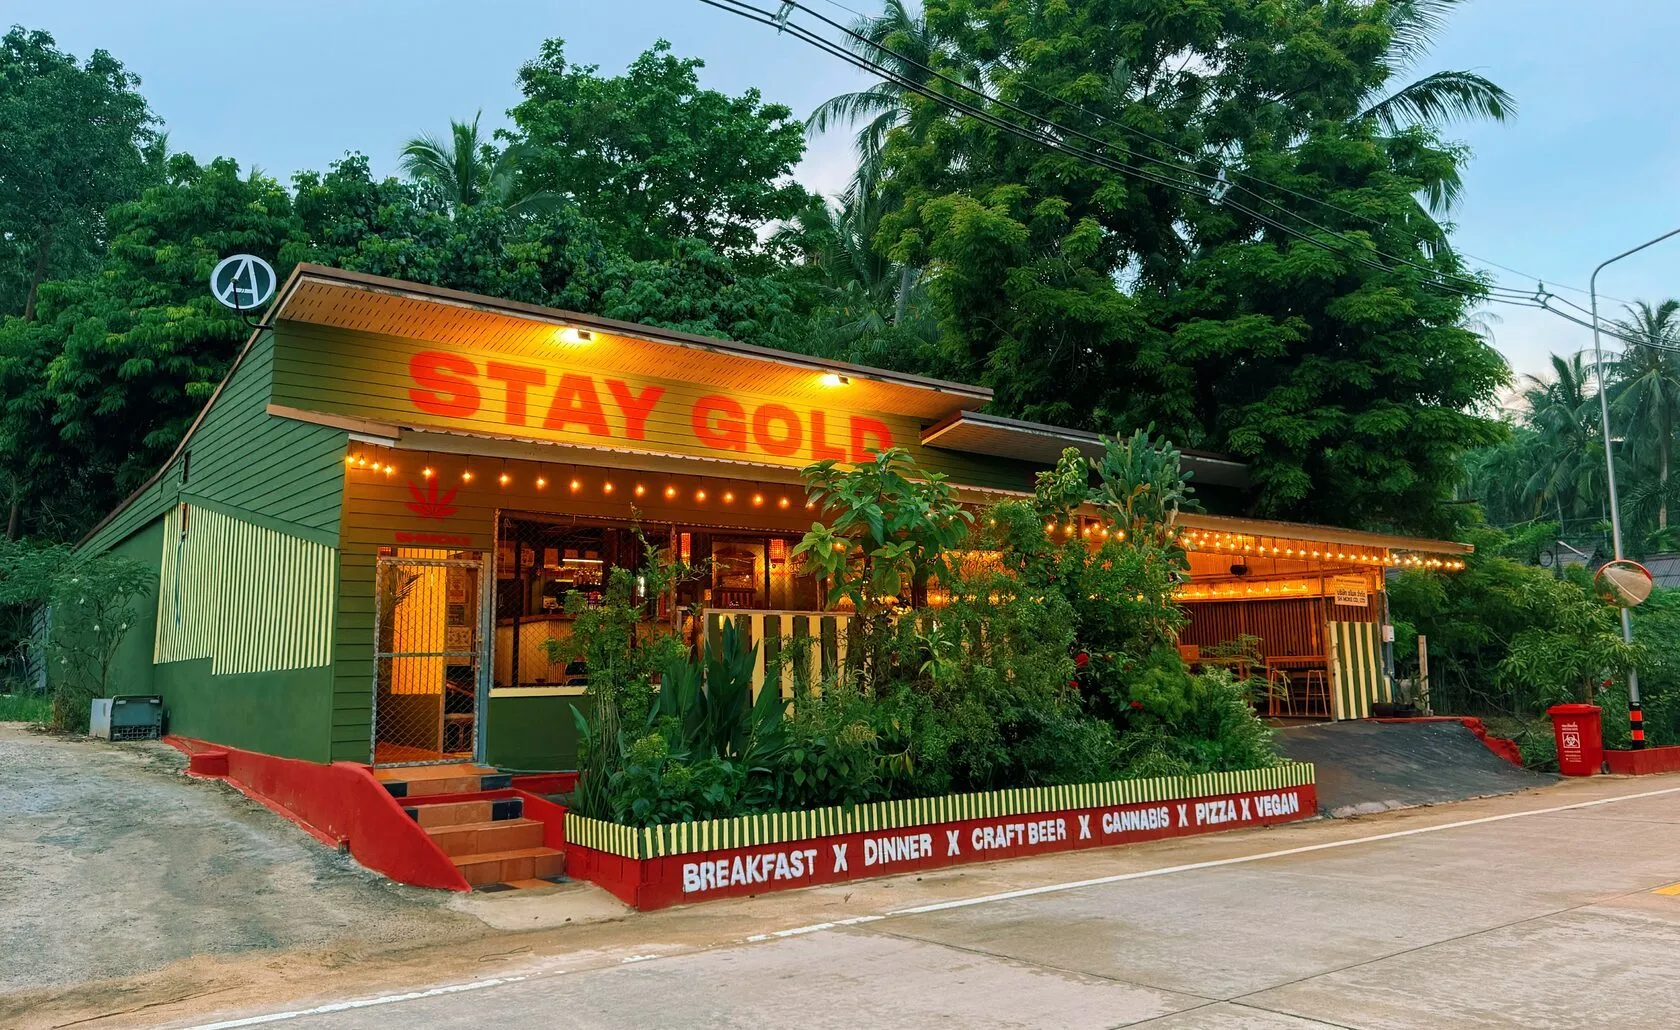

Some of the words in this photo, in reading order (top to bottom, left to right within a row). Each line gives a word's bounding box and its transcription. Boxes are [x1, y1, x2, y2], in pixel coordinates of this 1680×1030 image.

[408, 350, 665, 440] STAY
[691, 394, 894, 463] GOLD
[682, 848, 818, 893] BREAKFAST
[832, 843, 848, 873] X
[863, 833, 933, 866] DINNER
[946, 829, 961, 857] X
[971, 823, 1025, 851] CRAFT
[1028, 818, 1067, 845] BEER
[1078, 814, 1092, 840] X
[1102, 807, 1170, 834] CANNABIS
[1177, 803, 1189, 827] X
[1195, 799, 1237, 825] PIZZA
[1240, 798, 1252, 821] X
[1254, 792, 1299, 818] VEGAN
